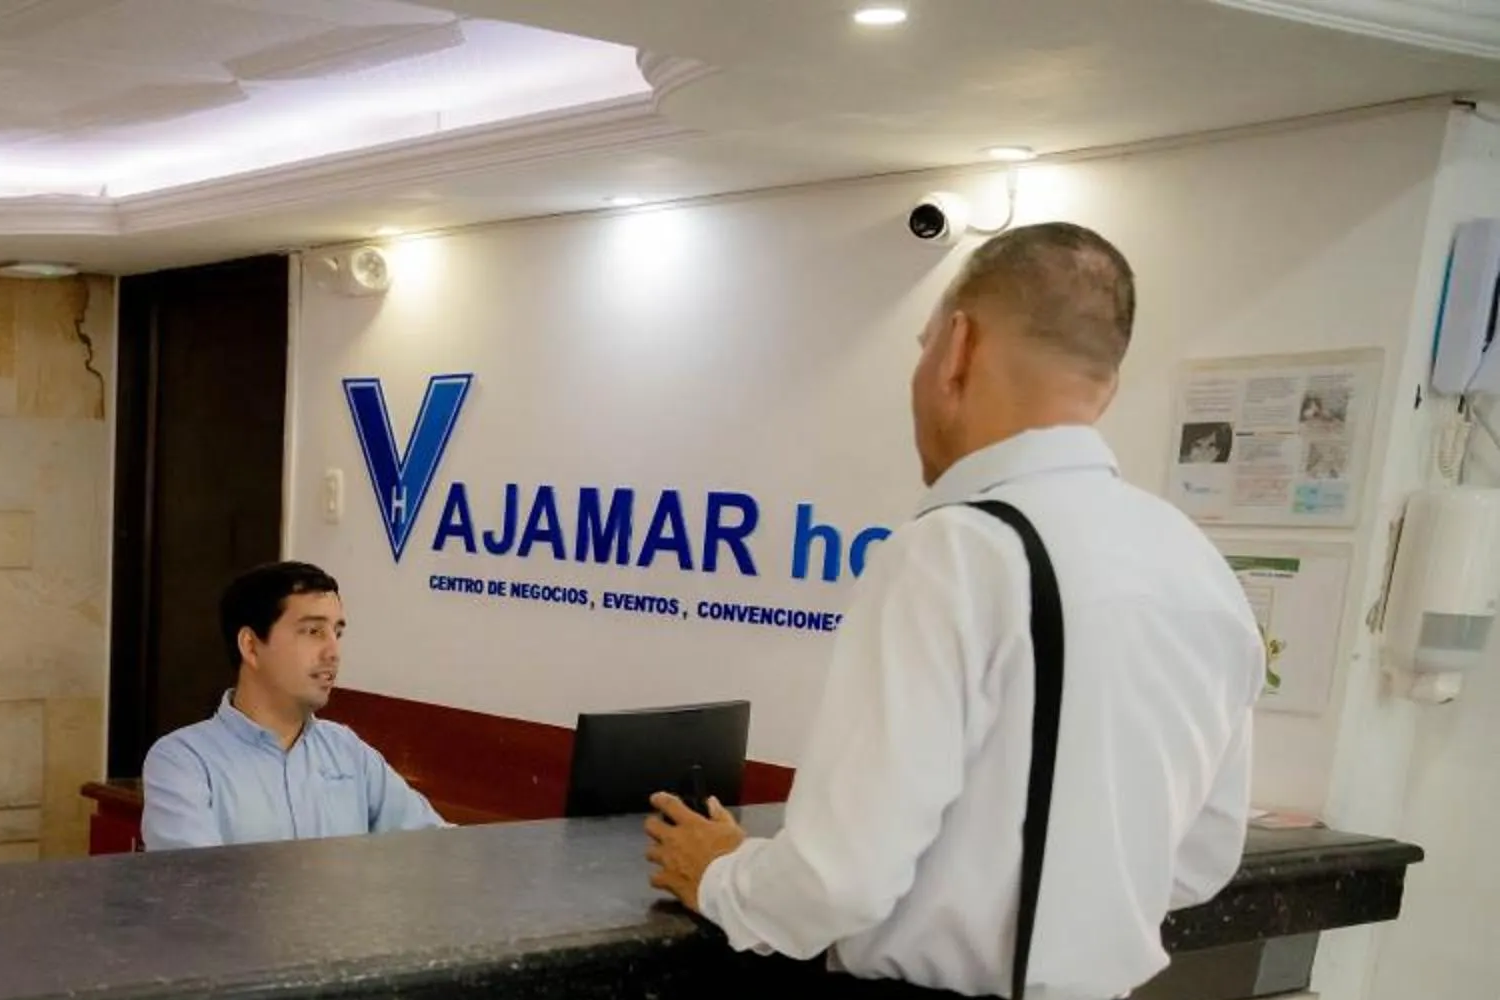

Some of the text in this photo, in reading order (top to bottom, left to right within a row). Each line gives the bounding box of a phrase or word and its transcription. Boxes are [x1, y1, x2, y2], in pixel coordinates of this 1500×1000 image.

[343, 373, 760, 576] VAJAMAR
[429, 575, 484, 594] CENTRO
[488, 580, 506, 597] DE
